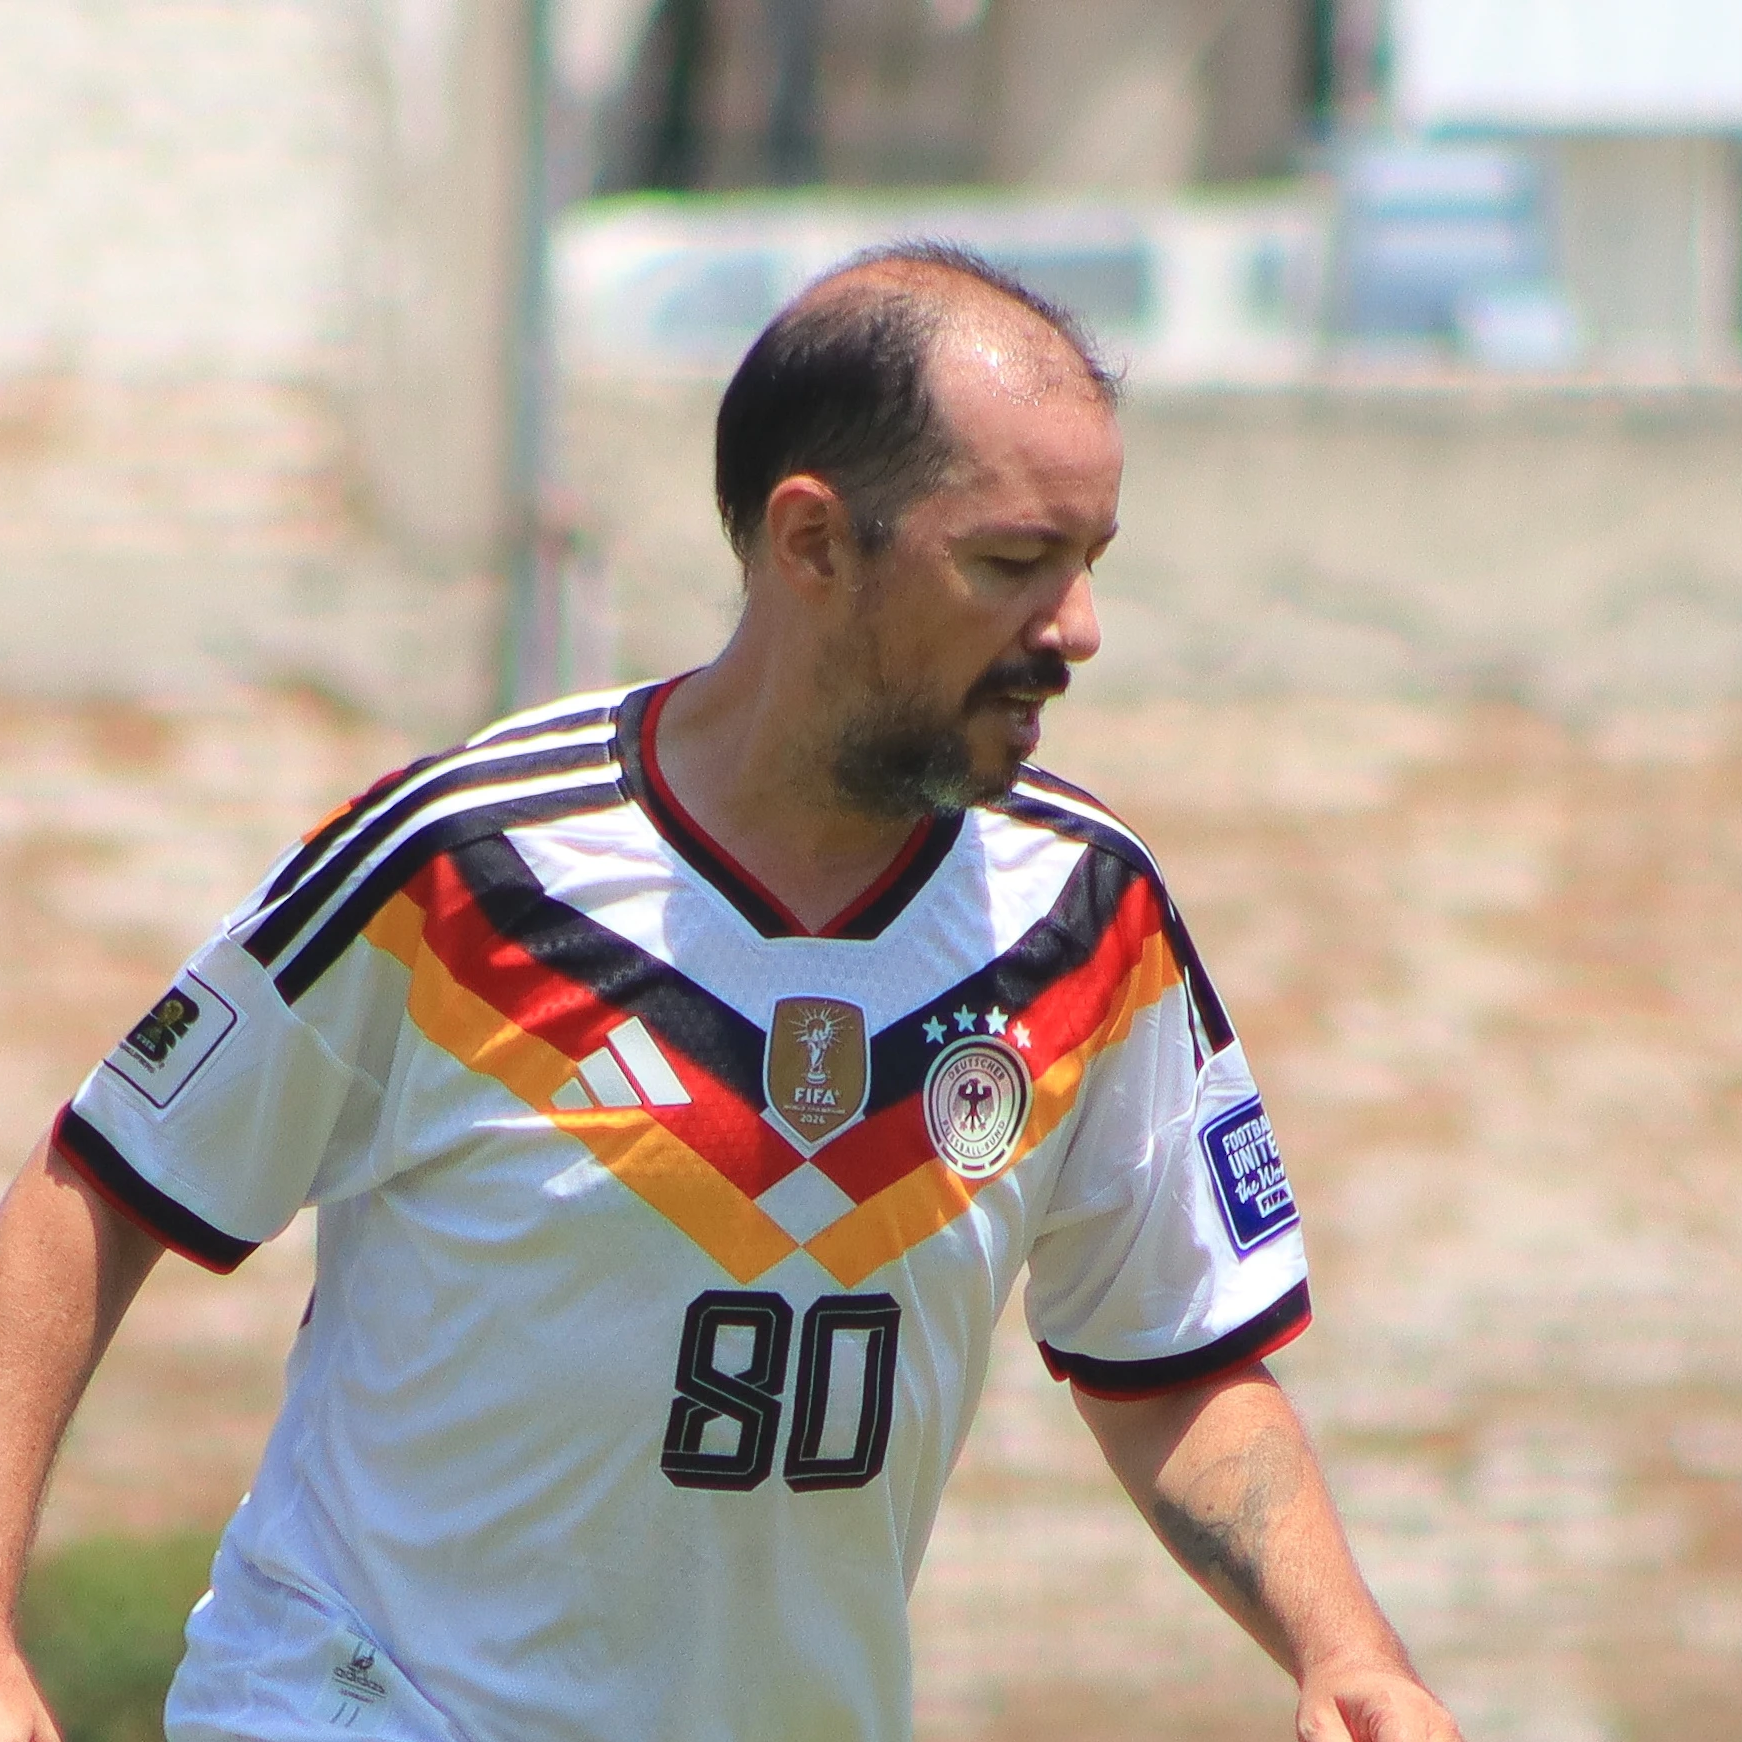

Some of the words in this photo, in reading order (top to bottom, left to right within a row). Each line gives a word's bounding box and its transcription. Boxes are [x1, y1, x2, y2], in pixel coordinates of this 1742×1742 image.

[947, 1056, 1007, 1083] DEUTSCHER
[794, 1087, 836, 1106] FIFA
[1234, 1176, 1260, 1204] the
[1260, 1189, 1289, 1212] FIFA
[660, 1289, 902, 1494] 80
